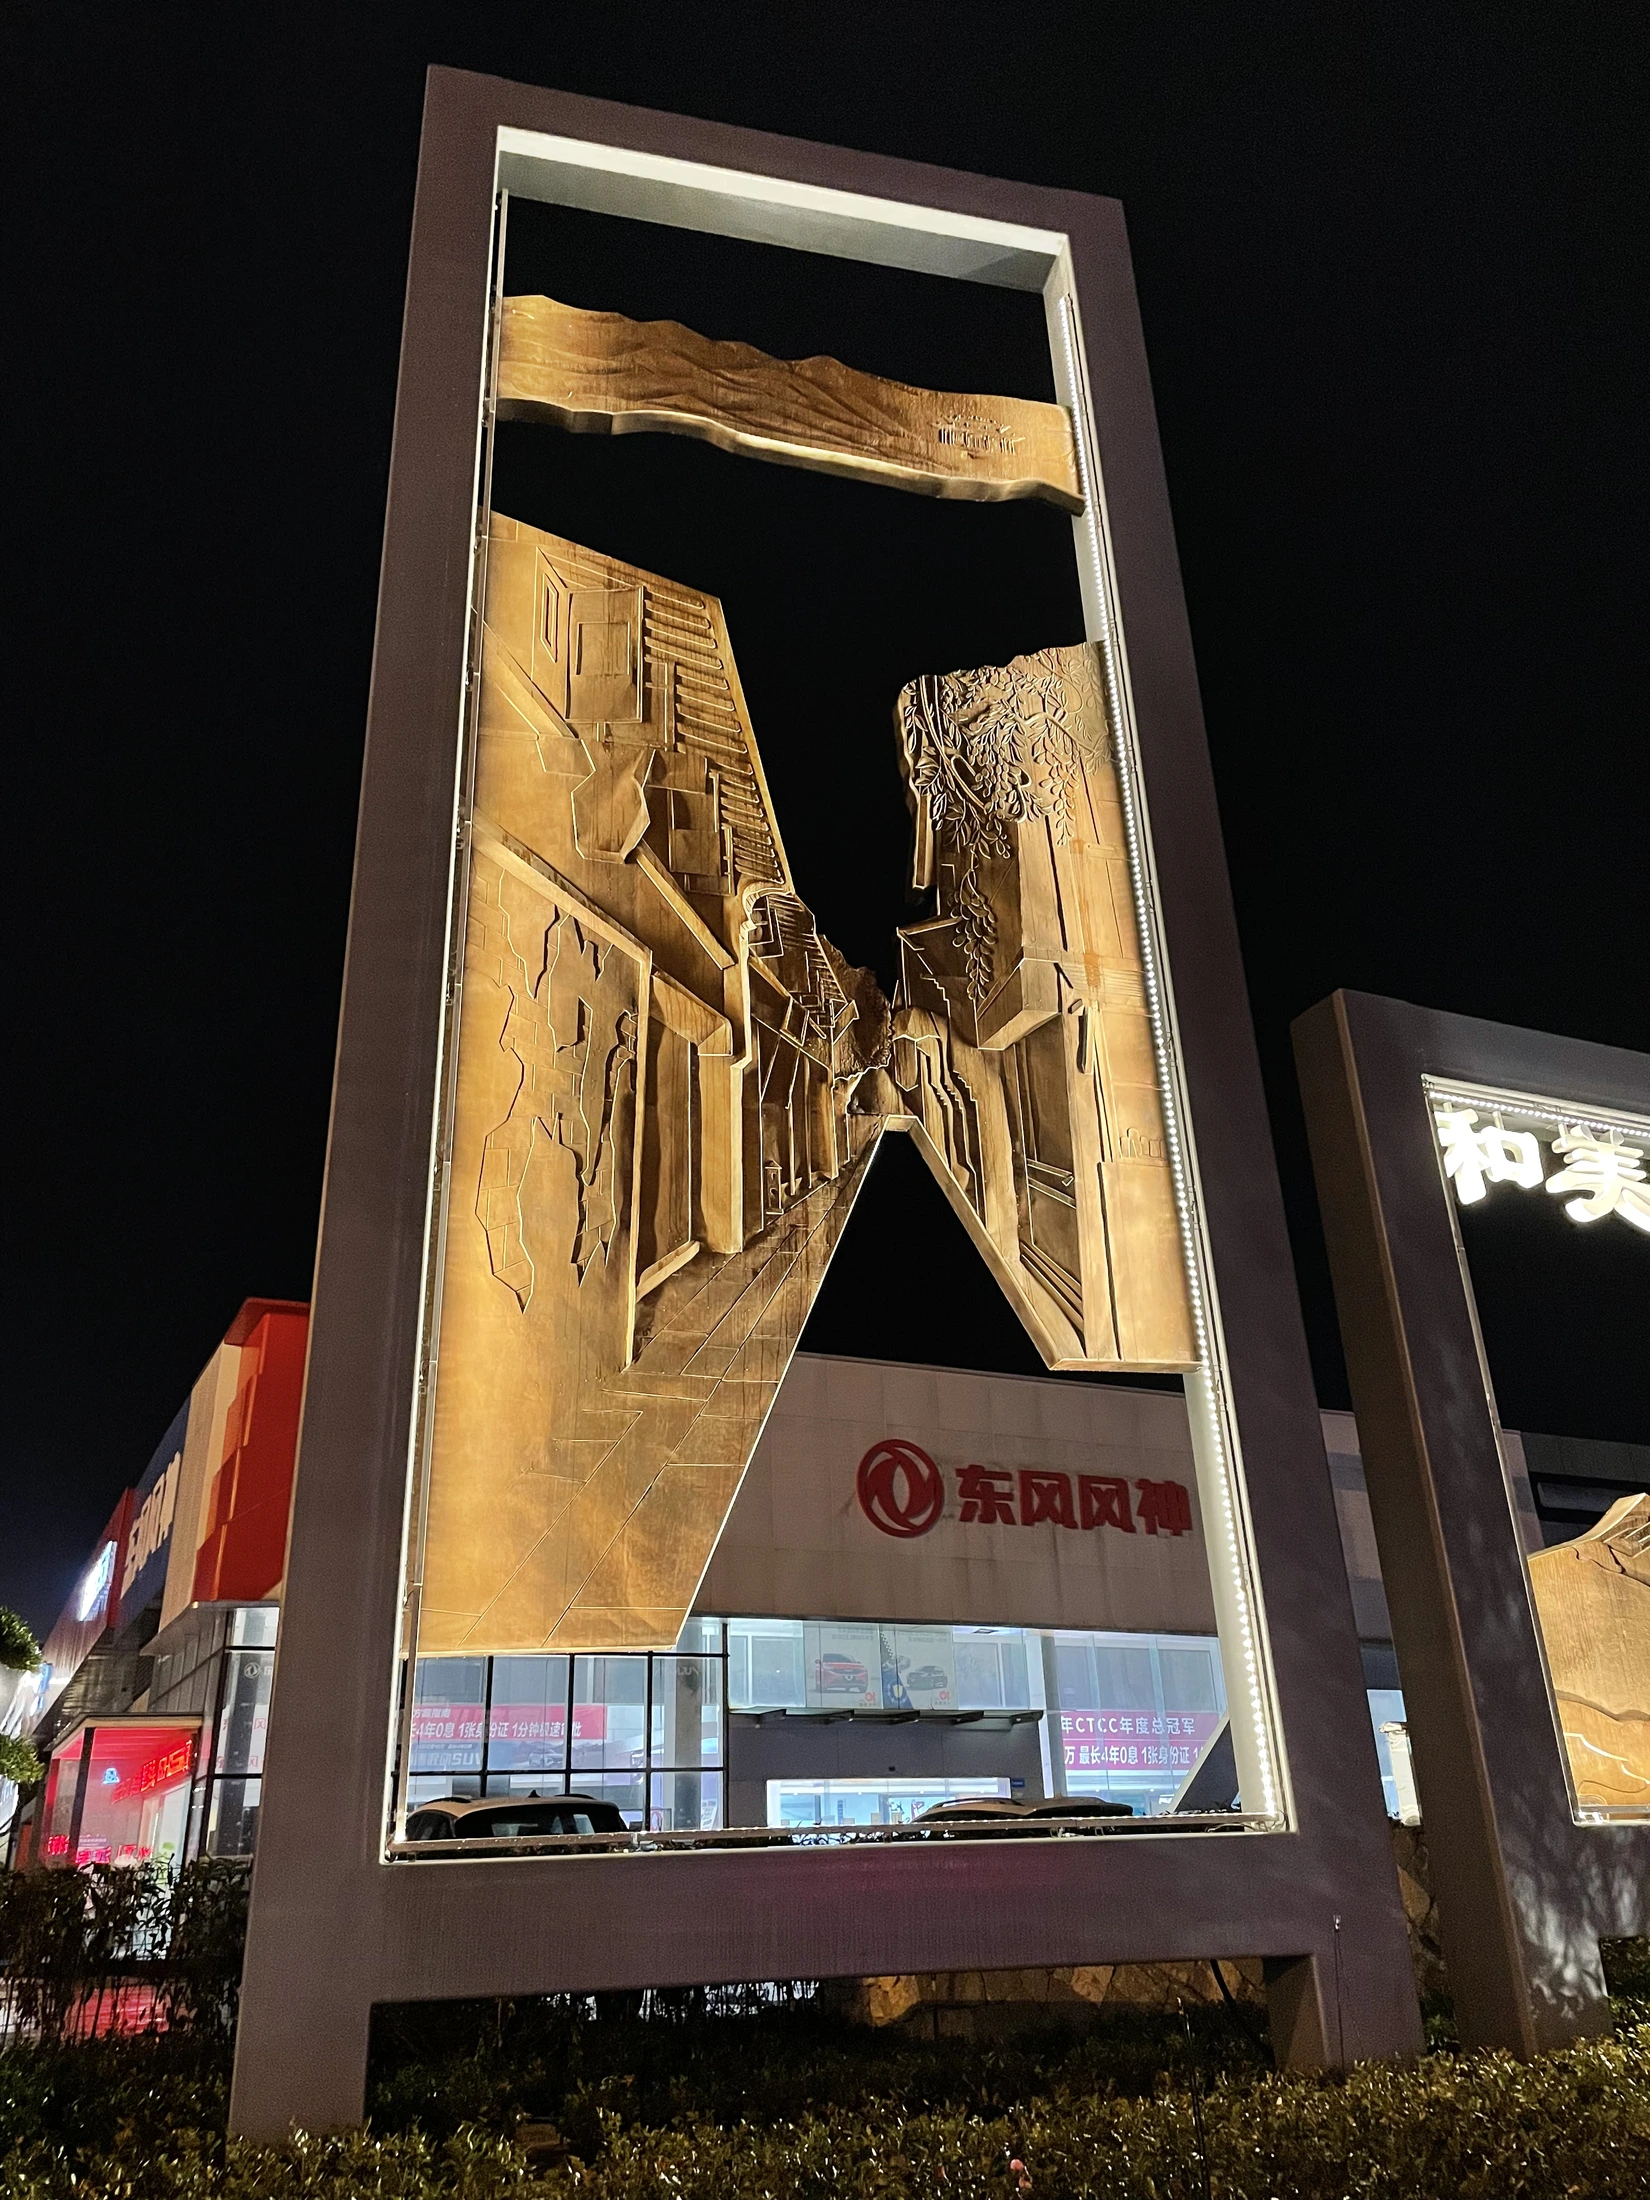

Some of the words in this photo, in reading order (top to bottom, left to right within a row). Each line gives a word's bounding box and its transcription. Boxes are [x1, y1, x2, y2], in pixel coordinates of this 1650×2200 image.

[1433, 1108, 1650, 1232] 和美
[955, 1464, 1193, 1537] 东风风神
[1079, 1745, 1139, 1766] 最长4年0息
[1141, 1745, 1191, 1765] 1张身份证
